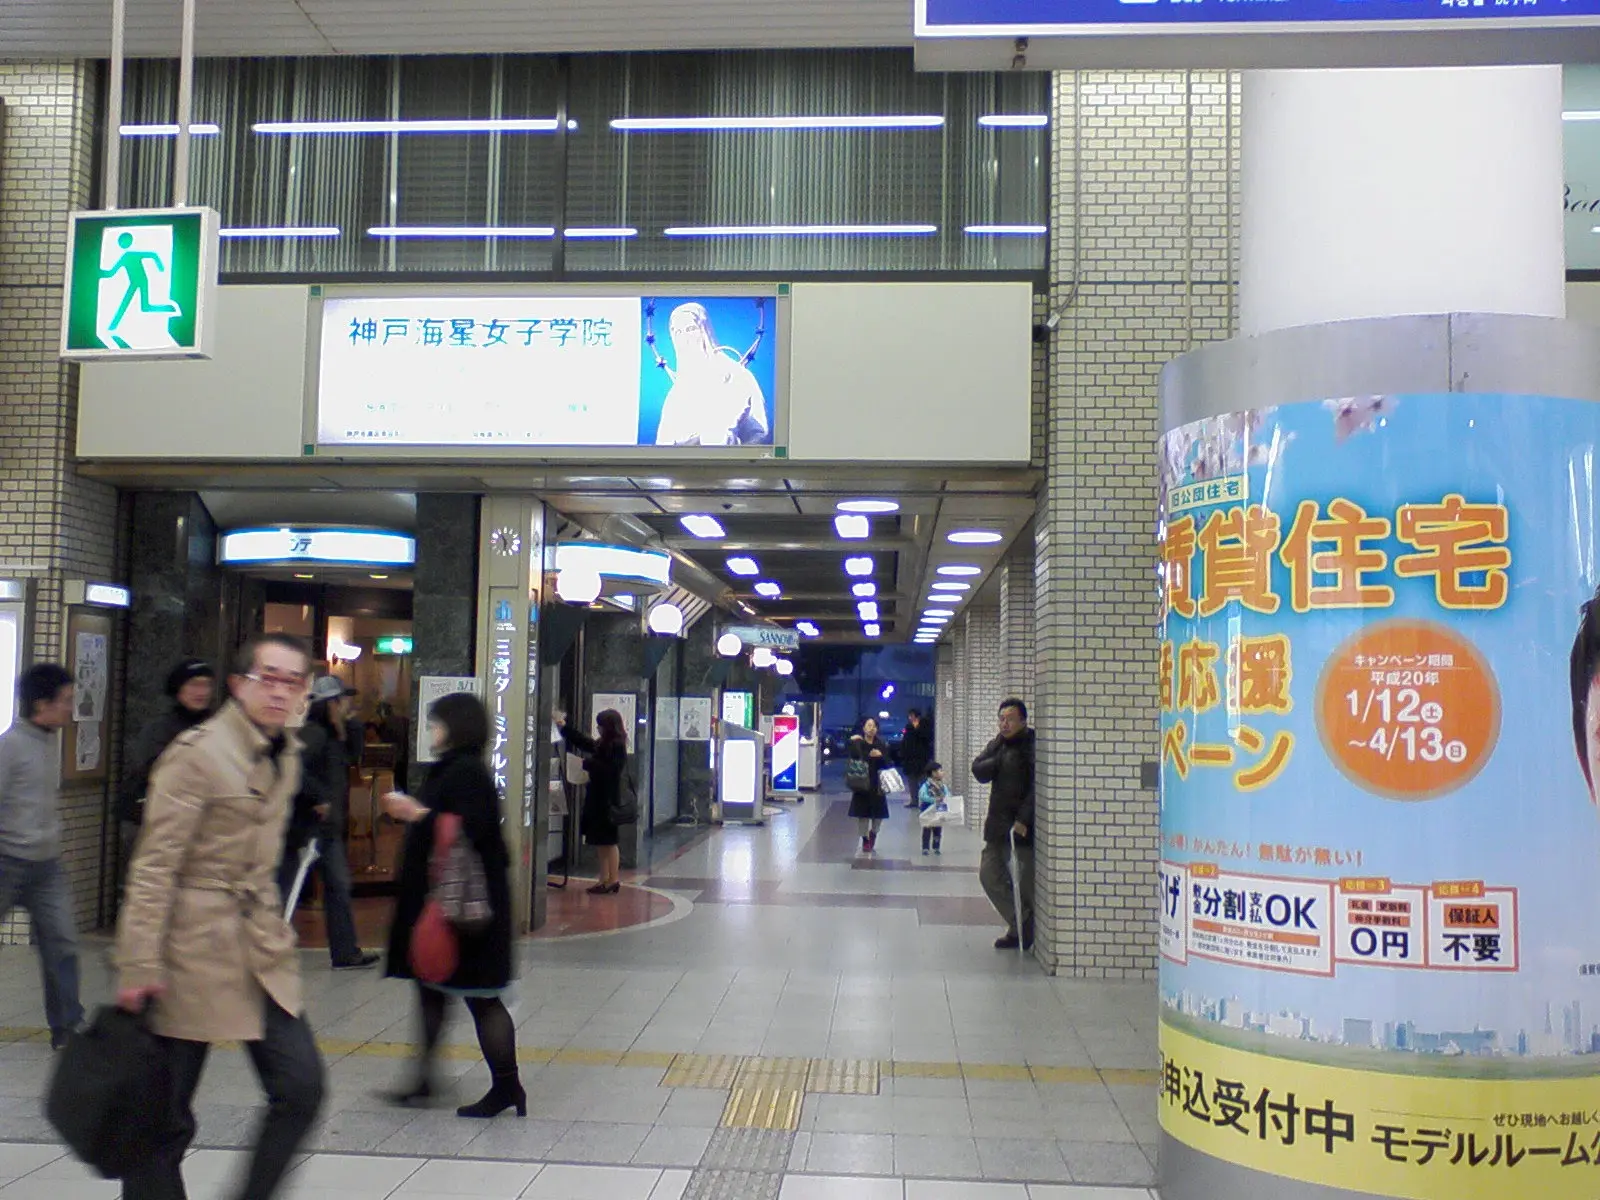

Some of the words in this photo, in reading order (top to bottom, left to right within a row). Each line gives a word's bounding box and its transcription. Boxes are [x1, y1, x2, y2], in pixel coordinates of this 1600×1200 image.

[349, 316, 613, 348] 神戸海星女子学院
[1371, 671, 1439, 686] 平成20年
[1449, 908, 1497, 924] 保証人
[1442, 933, 1501, 961] 不要
